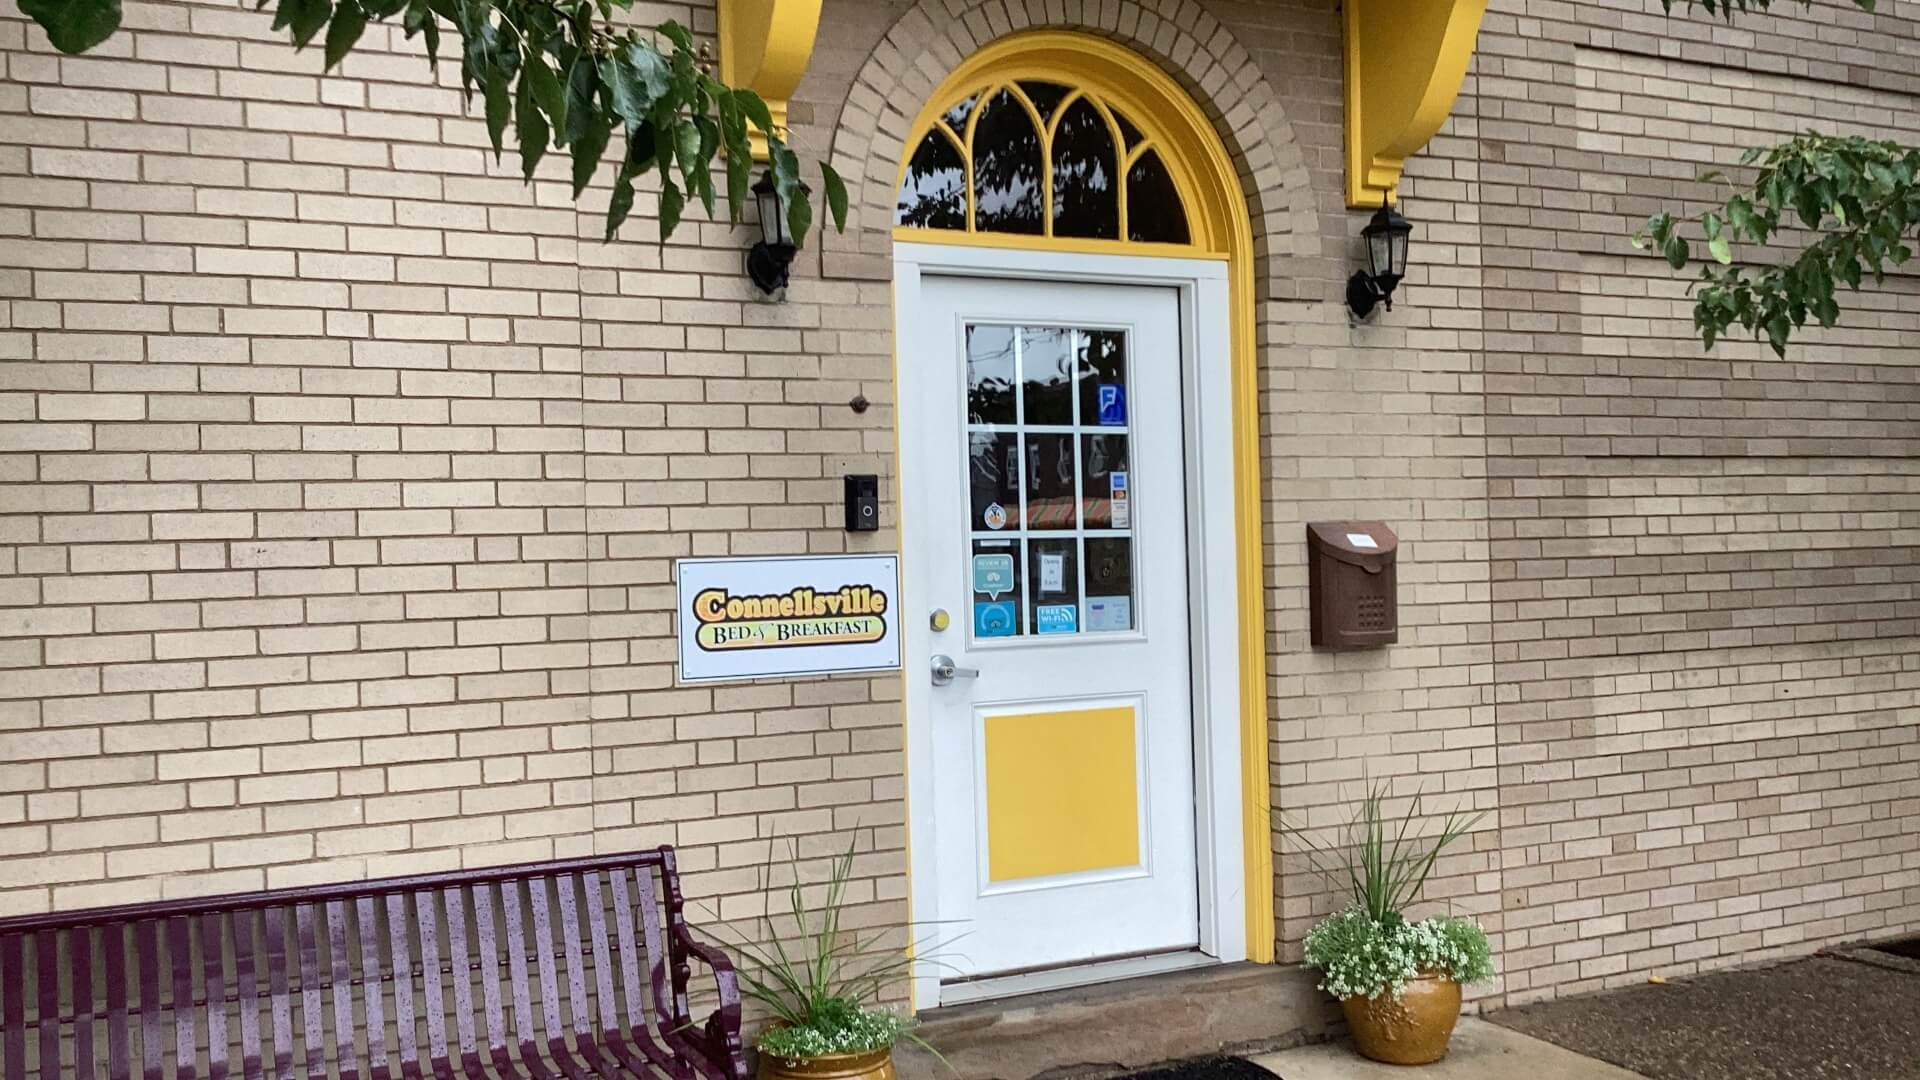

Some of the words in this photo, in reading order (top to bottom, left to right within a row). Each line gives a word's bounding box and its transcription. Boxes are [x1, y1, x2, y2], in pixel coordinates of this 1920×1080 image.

[694, 585, 886, 622] Connellsville
[713, 626, 750, 644] BED
[777, 620, 872, 641] BREAKFAST
